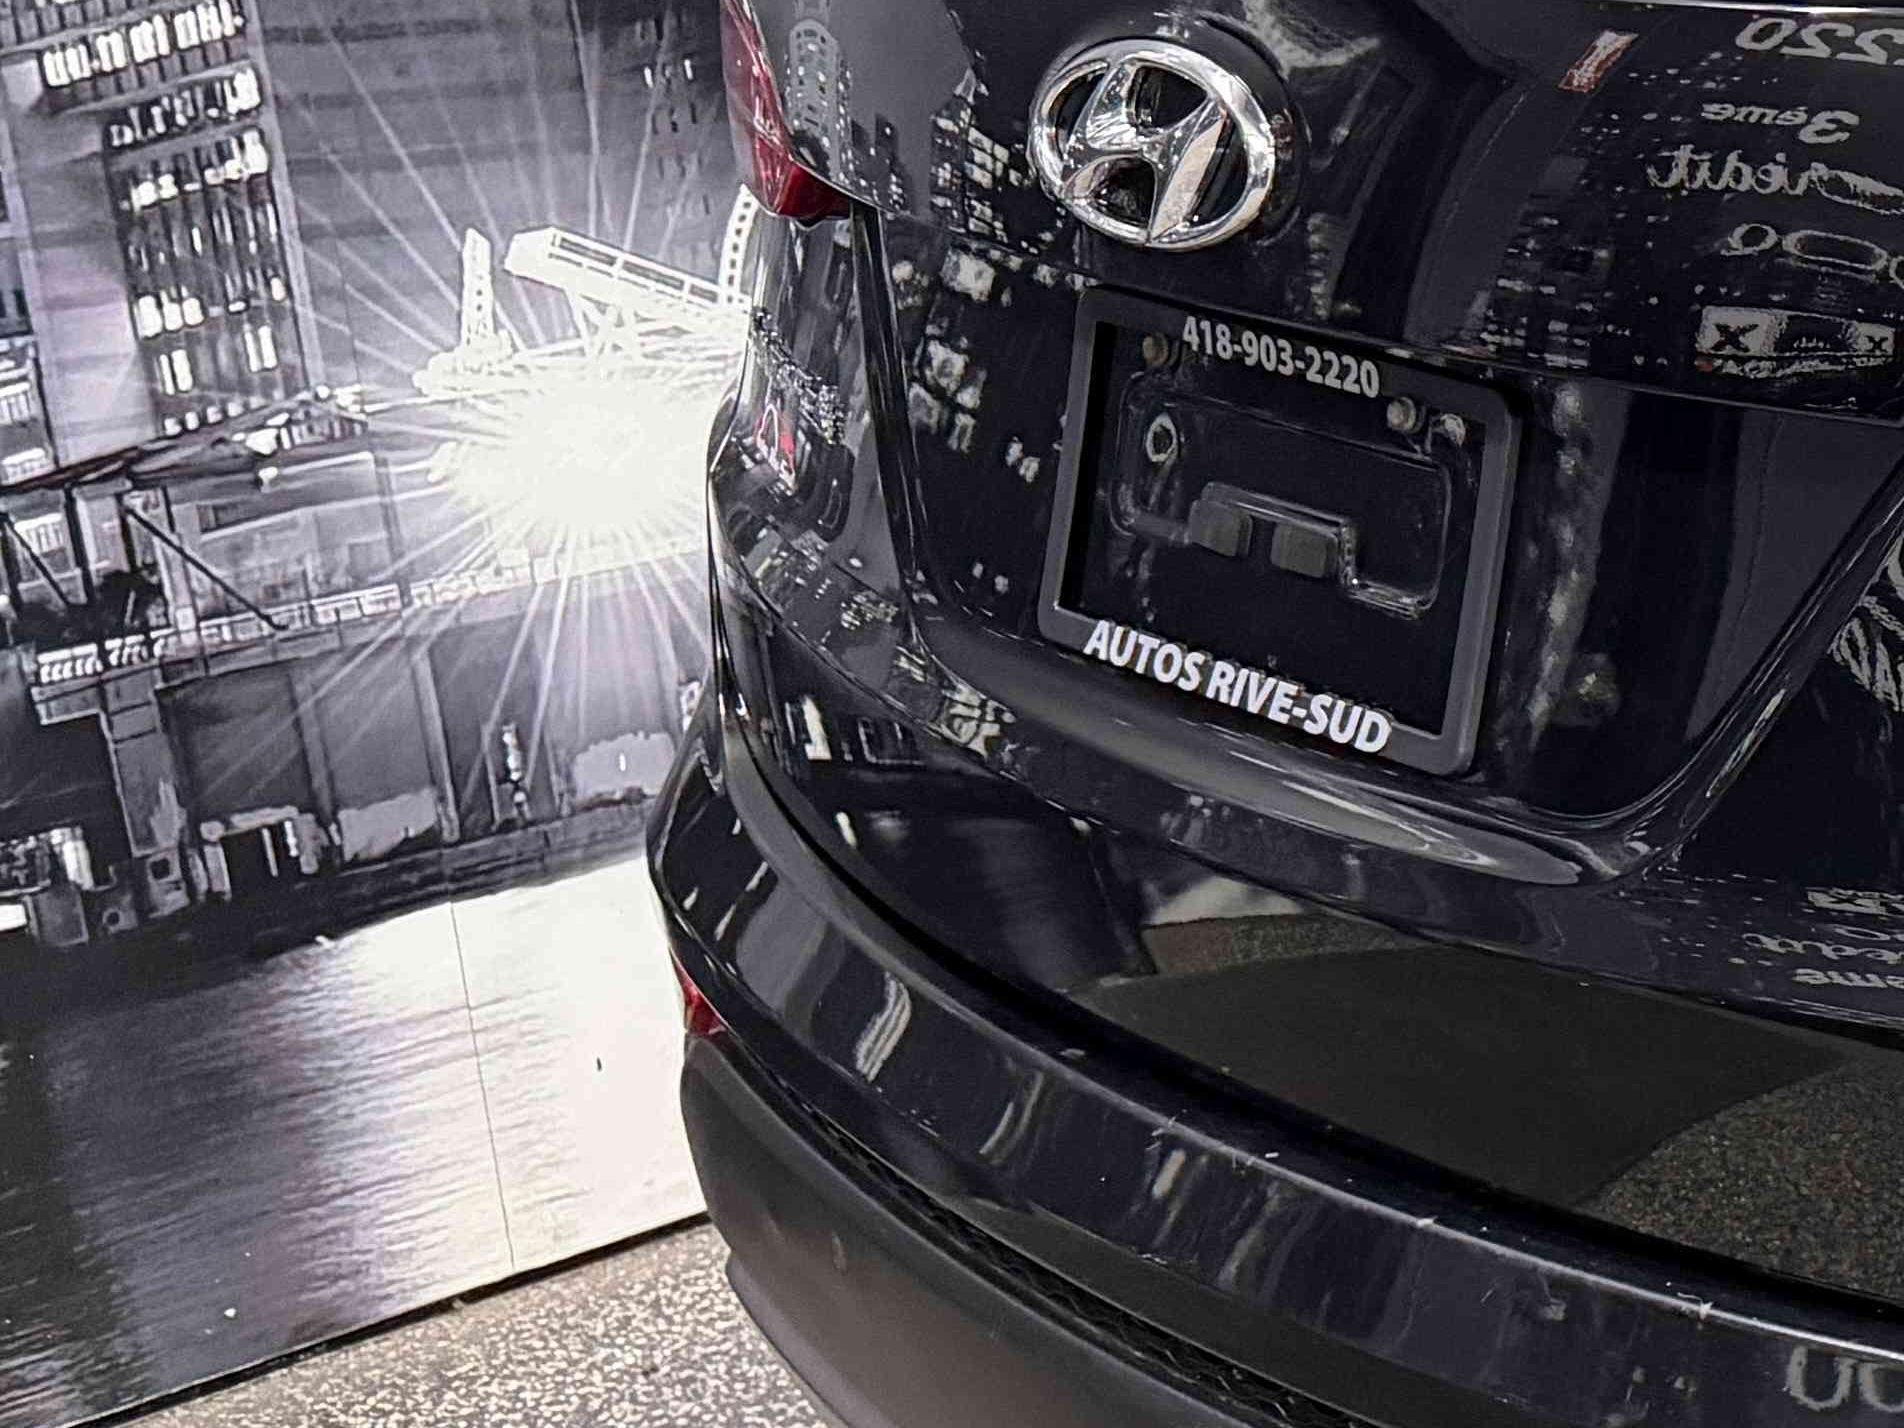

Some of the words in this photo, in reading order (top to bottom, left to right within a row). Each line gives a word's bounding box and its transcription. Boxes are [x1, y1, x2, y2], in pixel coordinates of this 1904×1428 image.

[1182, 315, 1380, 399] 418-903-2220
[1083, 619, 1207, 693] AUTOS
[1205, 660, 1393, 754] RIVE-SUD
